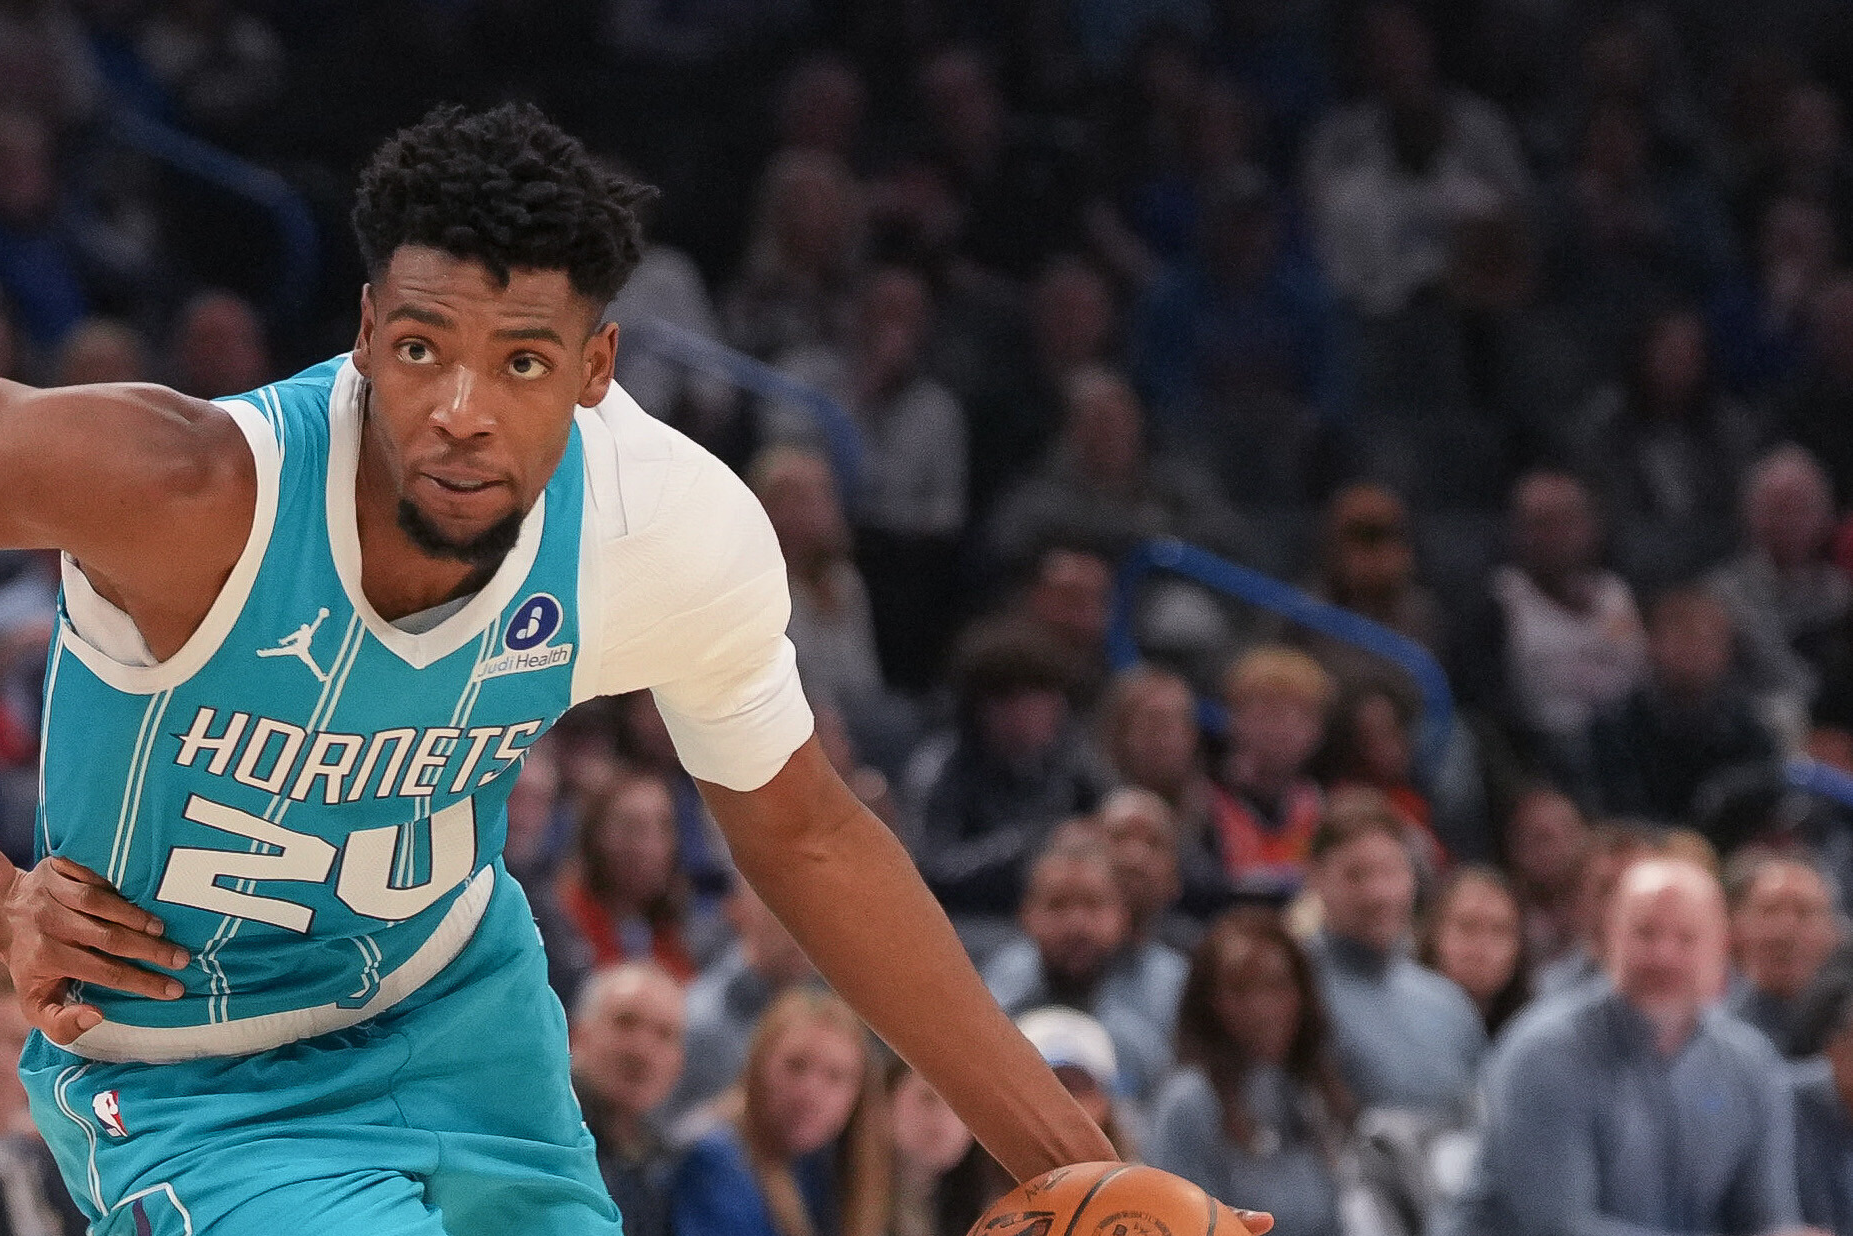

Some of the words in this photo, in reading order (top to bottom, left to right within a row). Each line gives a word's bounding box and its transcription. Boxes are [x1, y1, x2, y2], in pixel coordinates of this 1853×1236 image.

[477, 656, 515, 677] Judi
[515, 647, 568, 669] Health
[169, 706, 545, 805] HORNETS
[155, 792, 478, 935] 20
